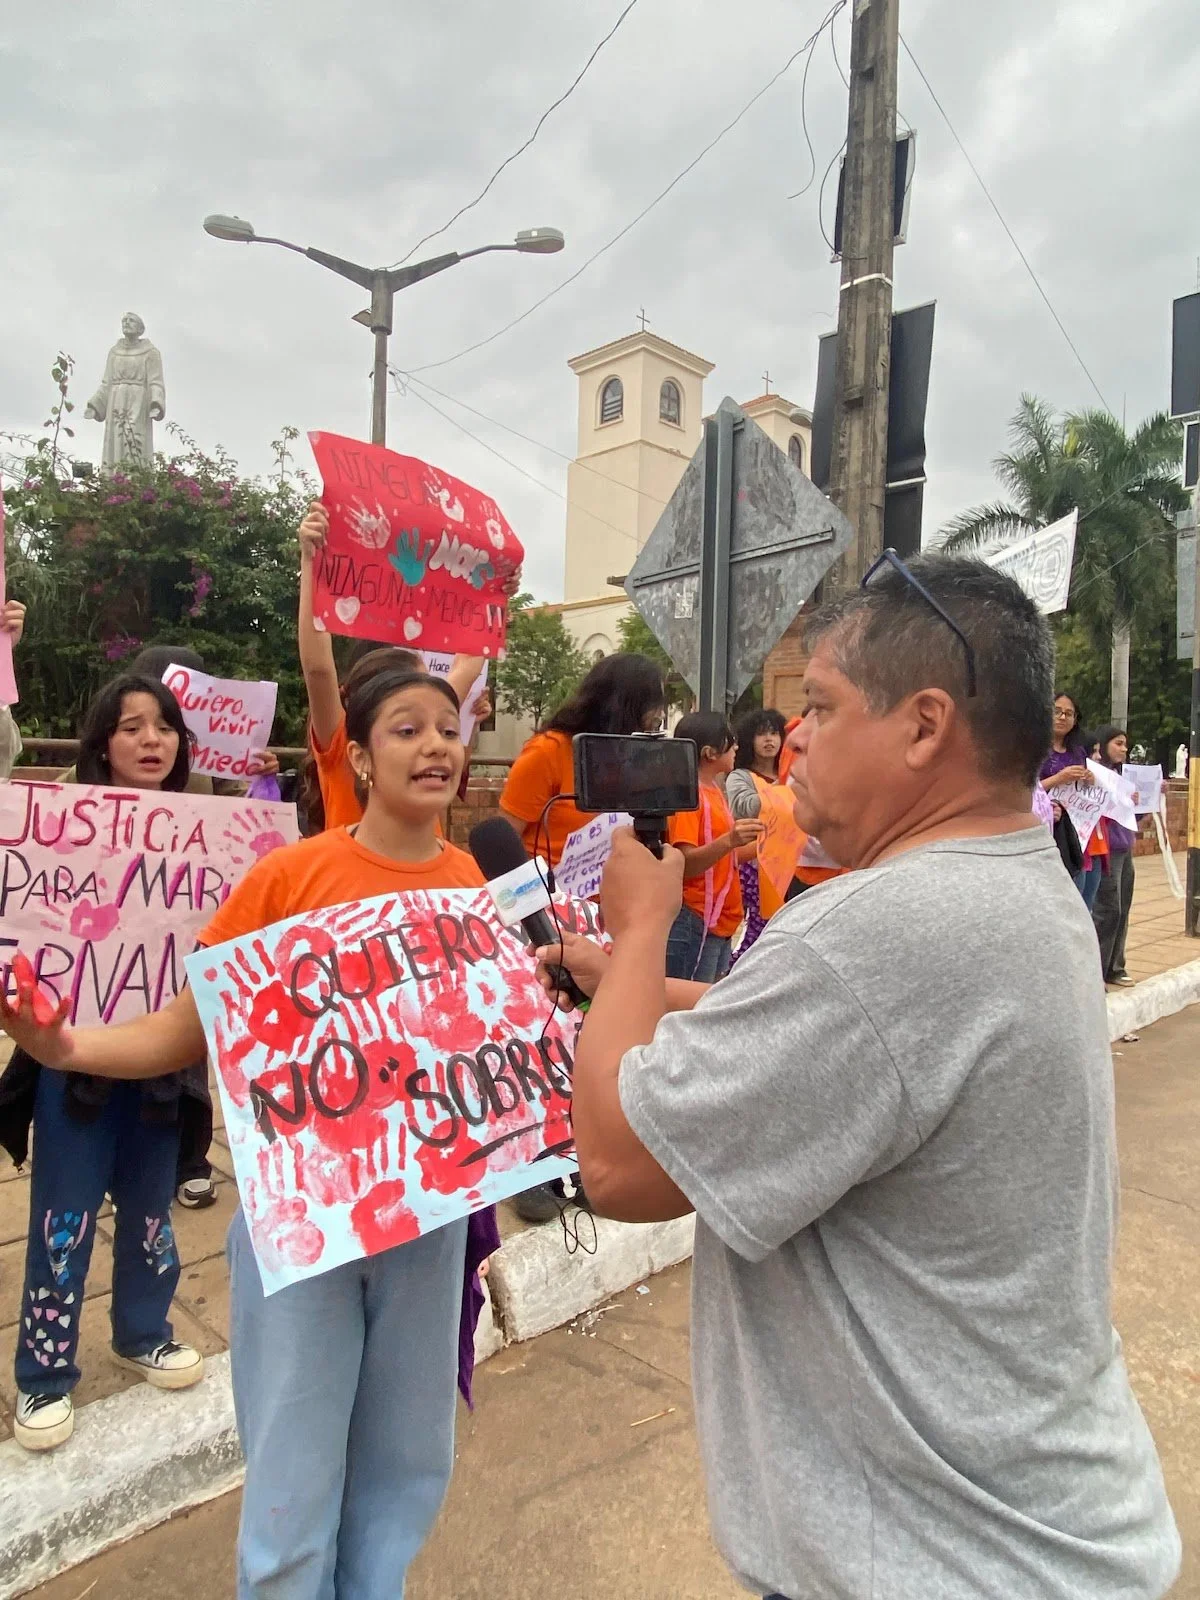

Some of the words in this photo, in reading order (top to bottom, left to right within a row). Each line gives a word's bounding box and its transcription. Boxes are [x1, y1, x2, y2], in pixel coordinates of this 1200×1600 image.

[429, 658, 450, 673] Hace
[167, 671, 243, 715] Quiero
[567, 834, 582, 849] NO
[0, 850, 101, 917] PARA
[290, 911, 499, 1018] QUIERO
